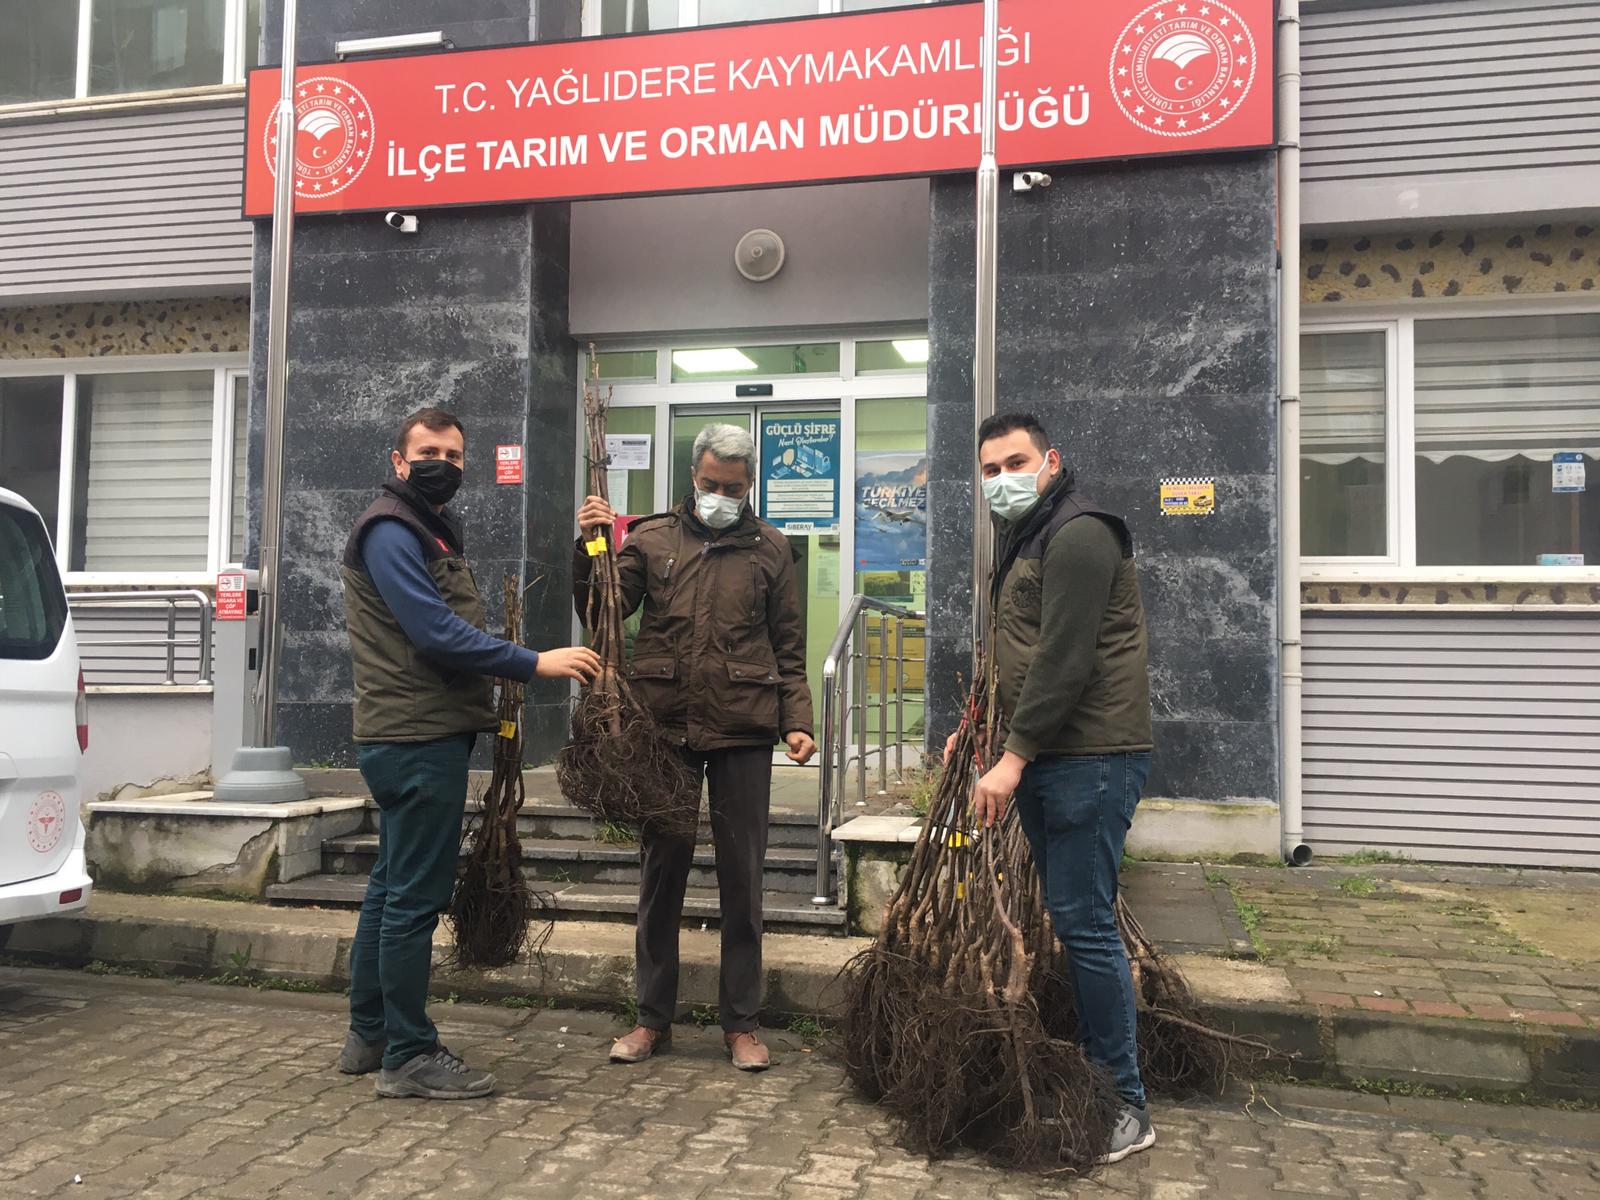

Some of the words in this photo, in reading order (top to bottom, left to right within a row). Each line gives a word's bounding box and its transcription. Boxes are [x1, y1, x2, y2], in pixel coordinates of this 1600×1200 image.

[1169, 21, 1198, 31] TARIM
[1200, 24, 1211, 34] VE
[1211, 33, 1229, 64] ORMAN
[434, 82, 495, 114] T.C.
[506, 62, 716, 109] YAĞLIDERE
[728, 26, 1030, 92] KAYMAKAMLIĞI
[387, 140, 466, 182] İLÇE
[476, 134, 588, 171] TARIM
[599, 130, 647, 163] VE
[660, 117, 805, 159] ORMAN
[819, 84, 1090, 147] MÜDÜRLÜĞÜ
[766, 422, 802, 437] GÜÇLÜ
[803, 421, 836, 437] ŞİFRE
[862, 484, 926, 498] TÜRKİYE
